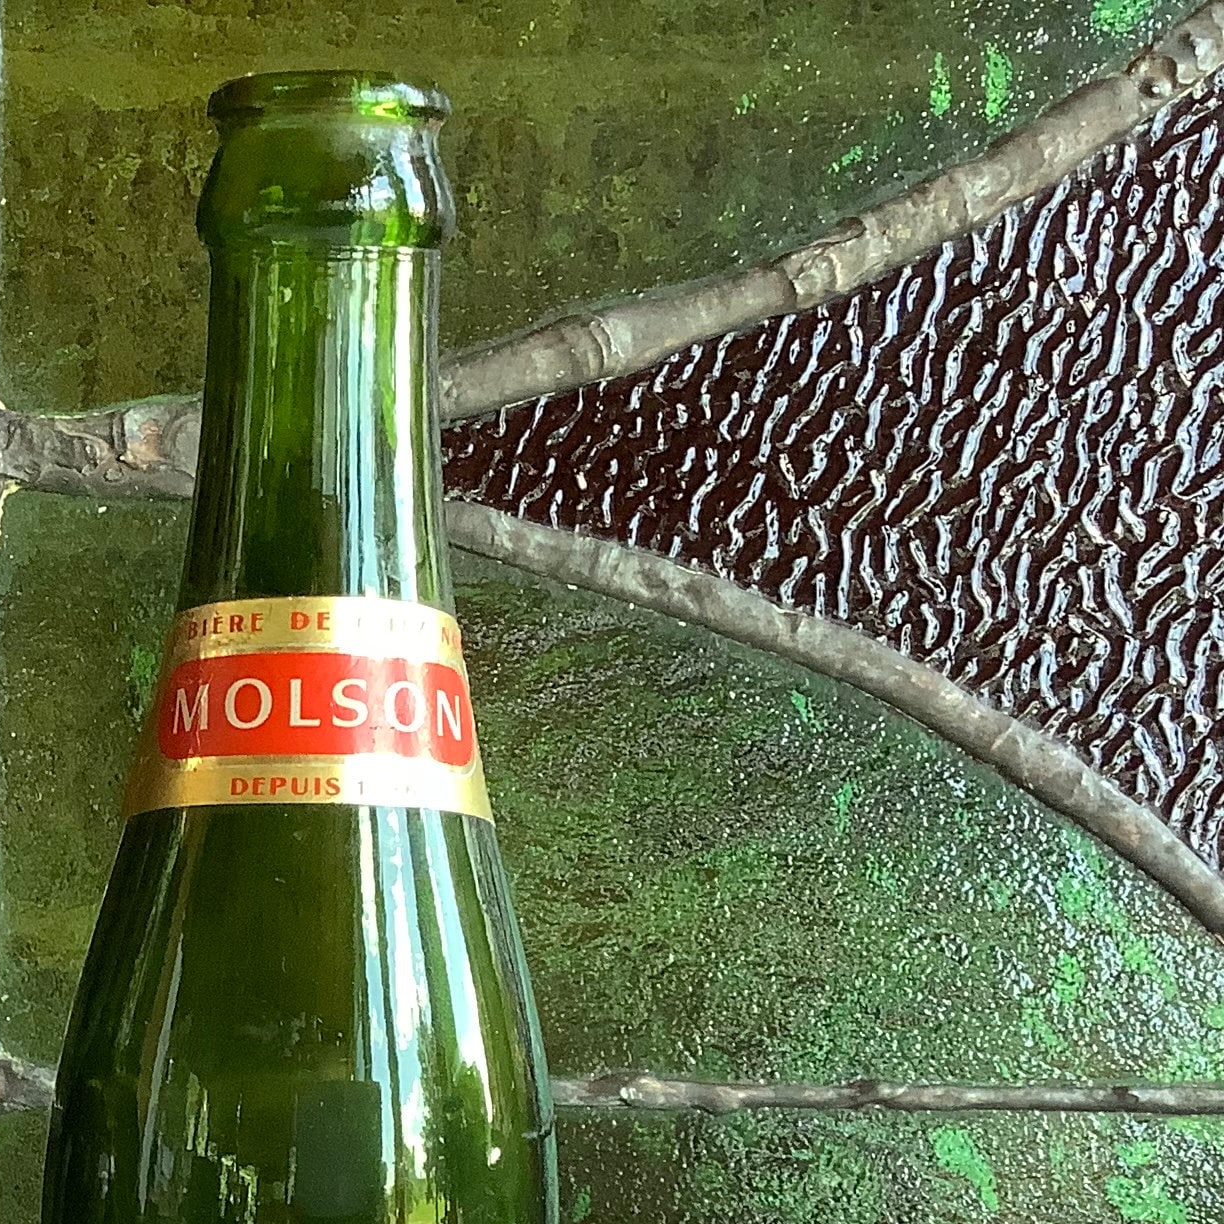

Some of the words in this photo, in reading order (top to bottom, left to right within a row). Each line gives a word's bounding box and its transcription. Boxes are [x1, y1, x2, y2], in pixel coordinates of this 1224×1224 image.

[187, 611, 264, 641] BIÈRE
[290, 611, 330, 631] DE
[173, 677, 463, 742] MOLSON
[231, 777, 341, 797] DEPUIS
